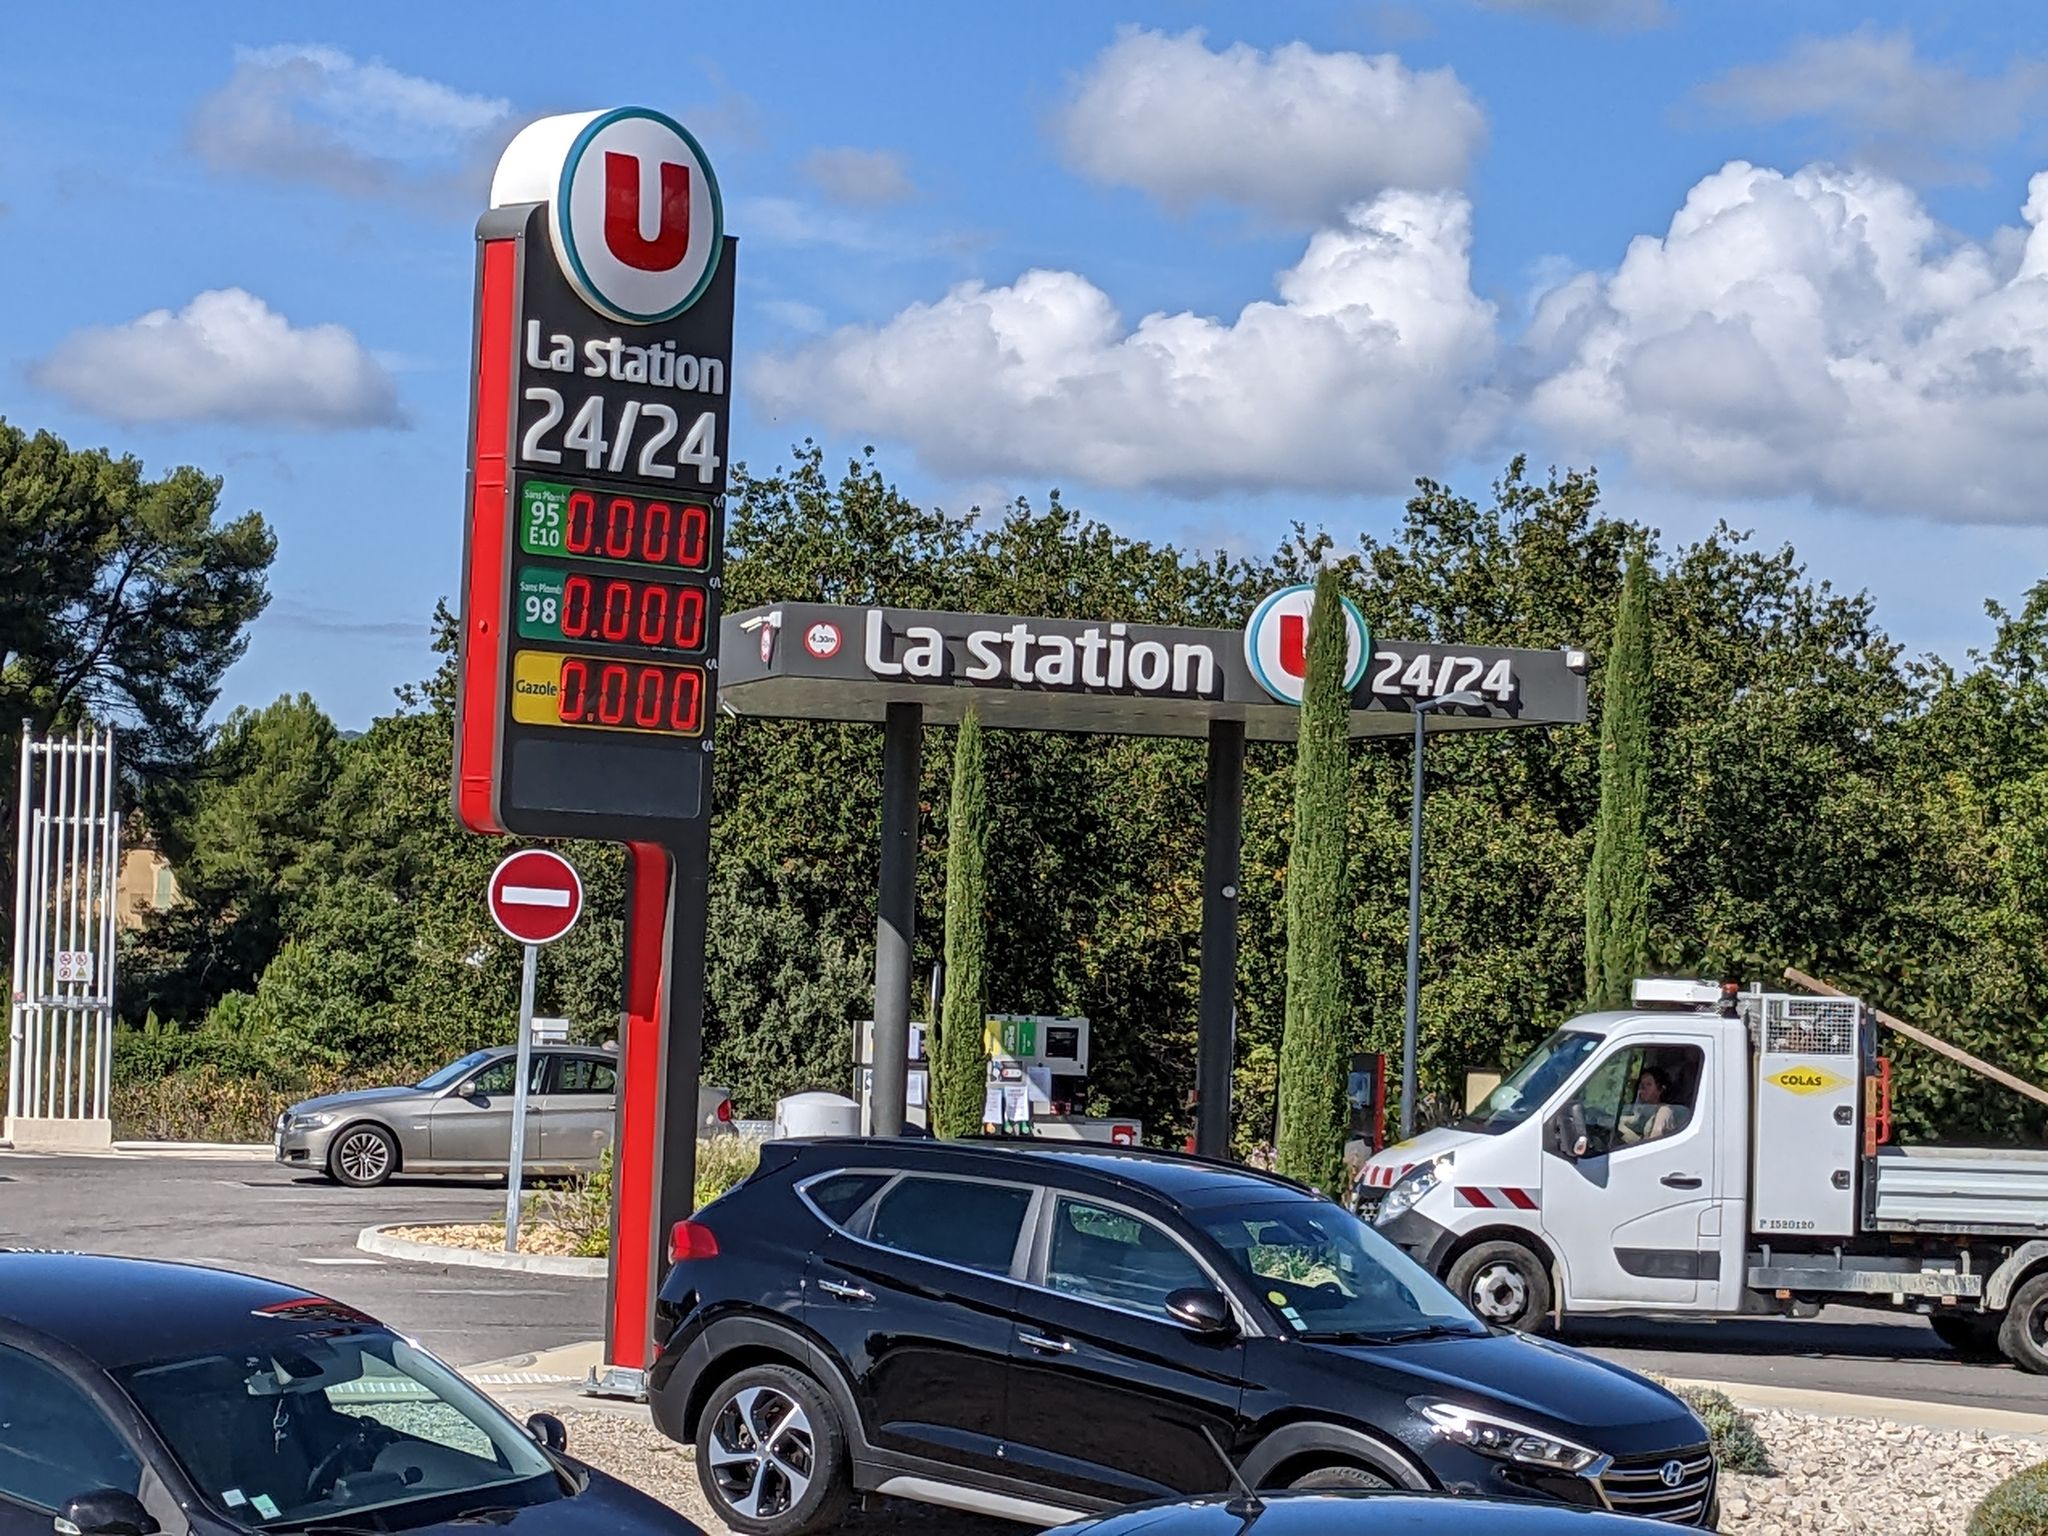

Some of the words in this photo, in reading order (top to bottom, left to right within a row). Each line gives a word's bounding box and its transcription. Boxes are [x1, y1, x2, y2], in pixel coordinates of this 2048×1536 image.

[605, 151, 690, 272] U
[526, 319, 574, 373] La
[584, 337, 724, 395] station
[522, 387, 720, 484] 24/24
[531, 501, 560, 527] 95
[529, 526, 560, 547] E10
[525, 596, 556, 624] 98
[865, 609, 943, 677] La
[965, 623, 1214, 694] station
[515, 679, 557, 696] Gazole
[1371, 651, 1515, 701] 24/24
[1780, 1075, 1822, 1086] COLAS
